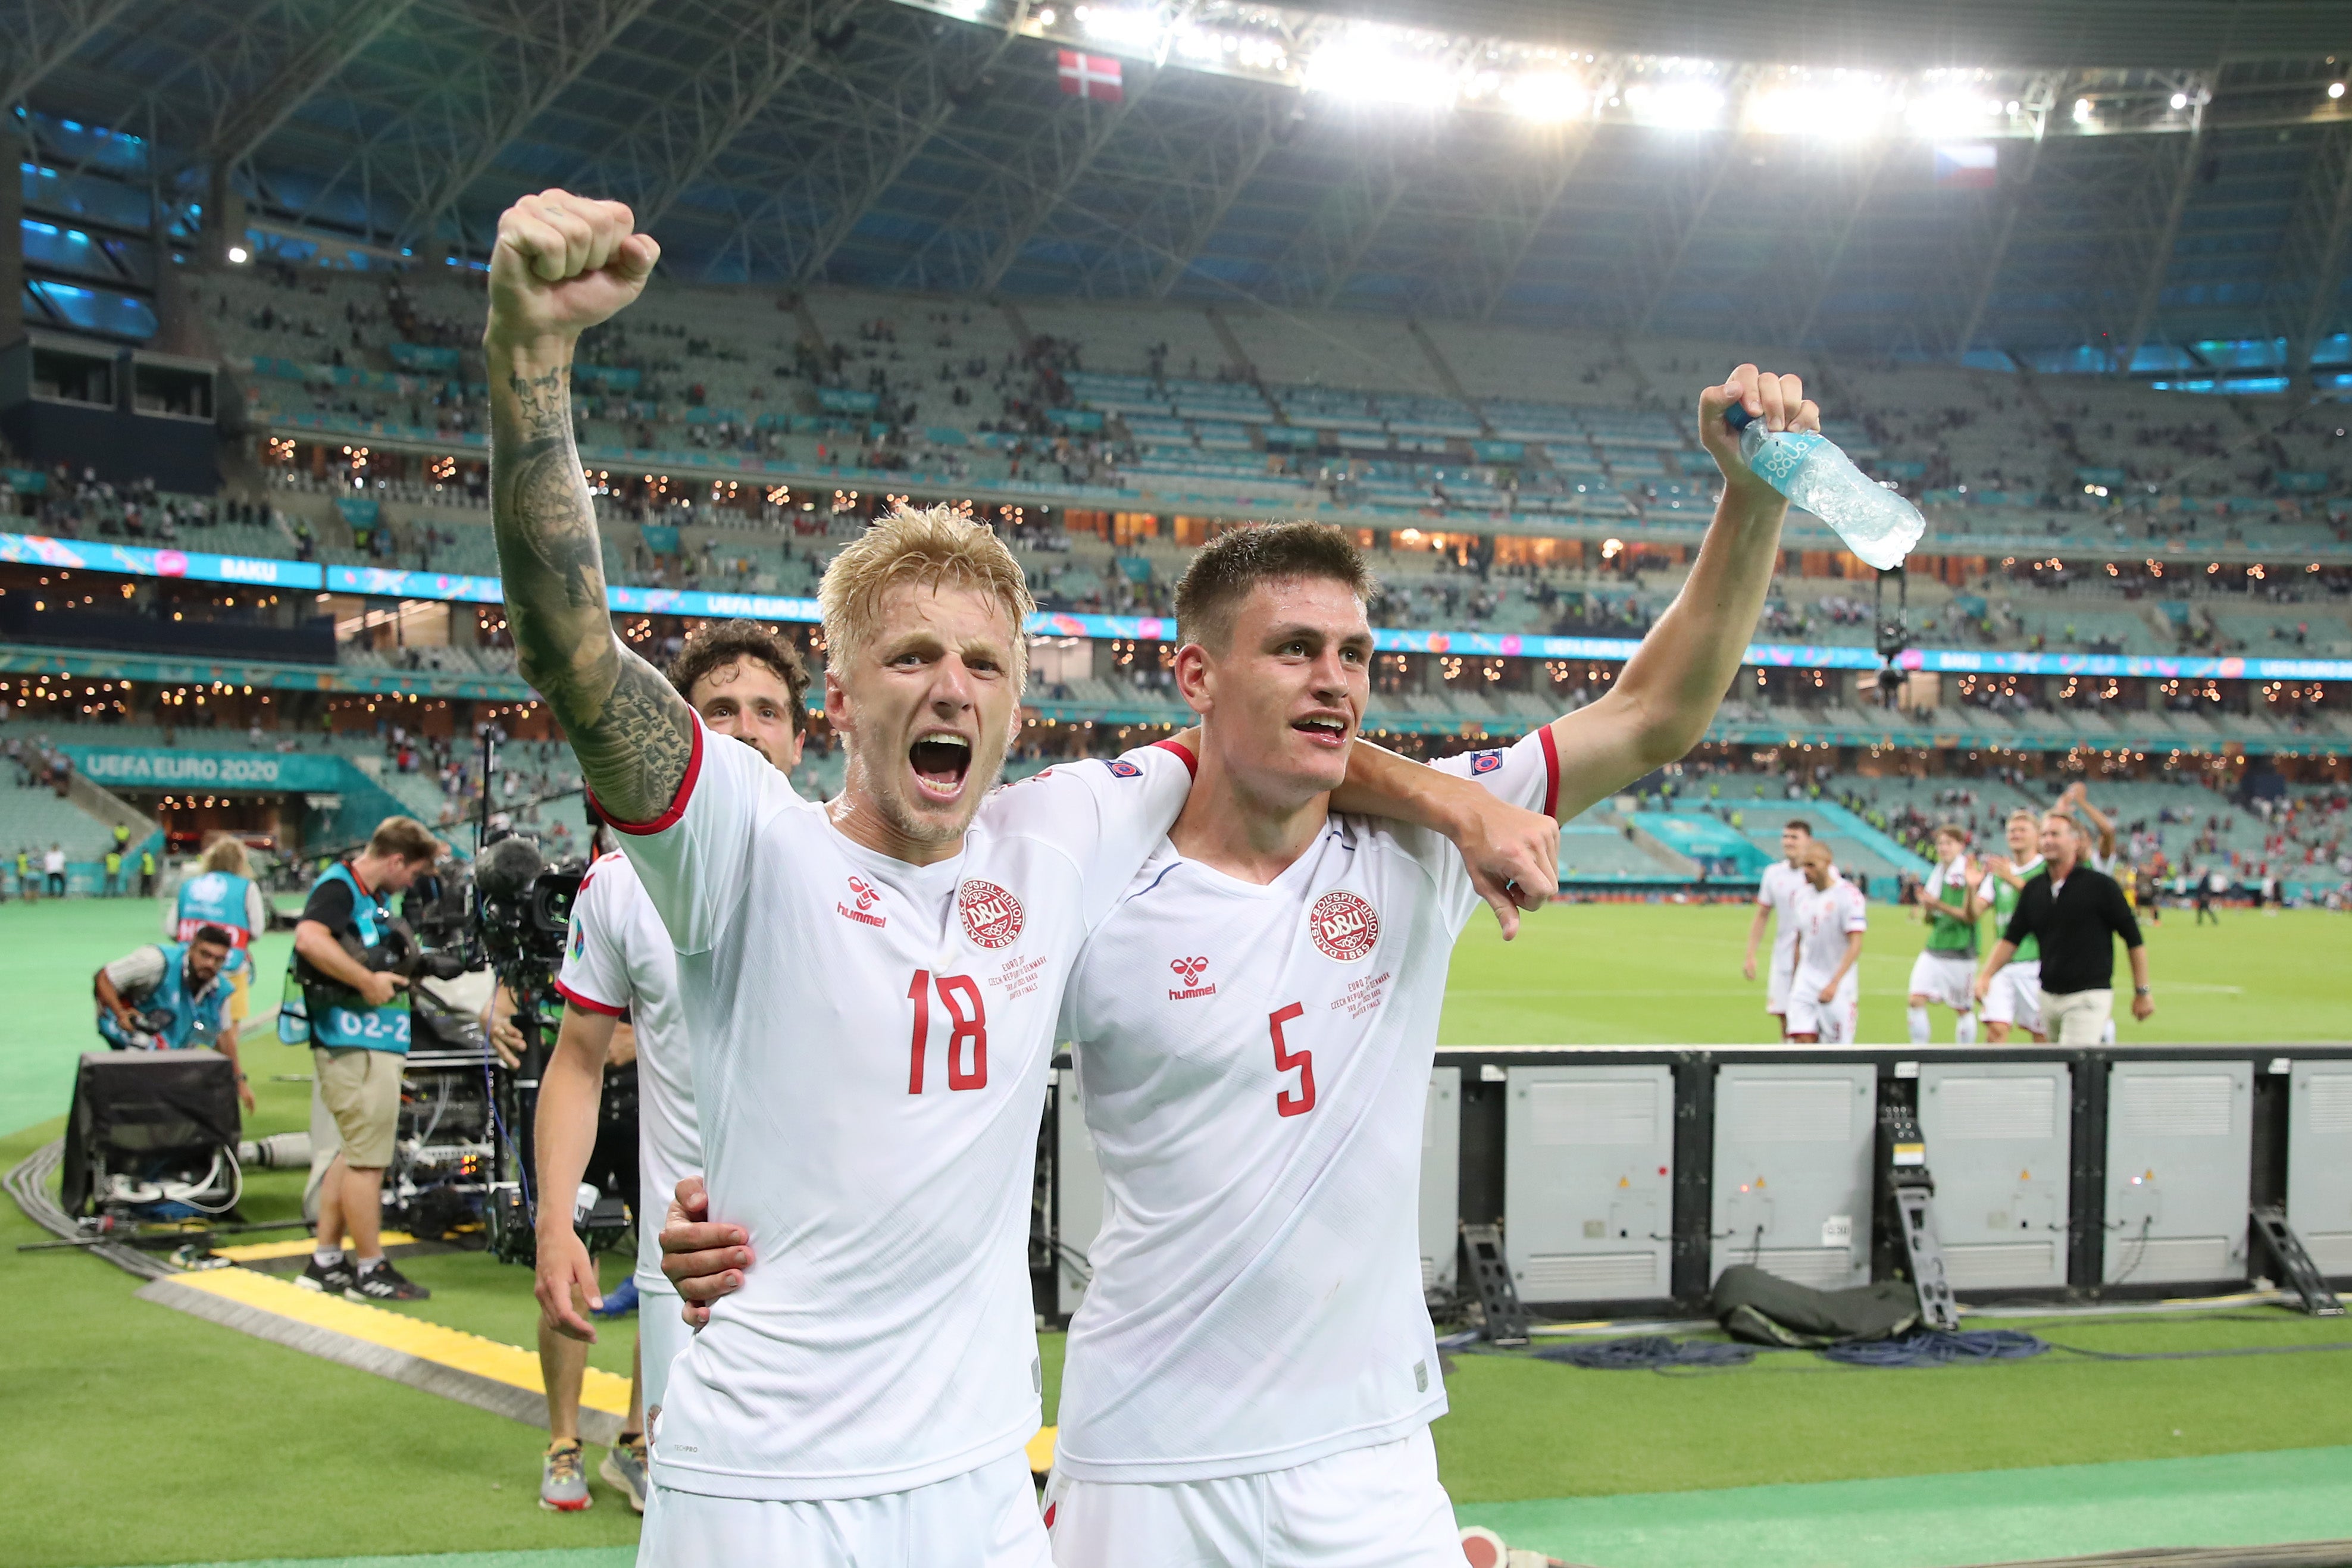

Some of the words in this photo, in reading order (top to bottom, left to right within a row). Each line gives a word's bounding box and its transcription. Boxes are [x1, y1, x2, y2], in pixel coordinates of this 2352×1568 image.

[1776, 441, 1809, 478] aqua
[220, 558, 277, 582] BAKU
[707, 596, 752, 615] UEFA
[753, 597, 799, 618] EURO
[1940, 652, 1981, 669] BAKU
[87, 754, 149, 777] UEFA
[154, 756, 218, 780] EURO
[218, 759, 279, 782] 2020
[837, 902, 886, 928] hummel
[967, 898, 1009, 928] DBU
[1321, 910, 1366, 941] DBU
[990, 929, 1018, 948] 1889
[1311, 920, 1338, 957] DANSK
[1343, 944, 1370, 960] 1889
[1002, 958, 1018, 972] EURO
[1023, 955, 1047, 973] DENMARK
[1021, 982, 1038, 995] FINALS
[1169, 983, 1216, 1000] hummel
[1331, 997, 1346, 1010] CZECH
[1369, 972, 1390, 988] DENMARK
[1348, 979, 1364, 992] EURO
[1366, 999, 1380, 1010] FINALS
[906, 969, 987, 1094] 18
[1269, 1001, 1315, 1118] 5
